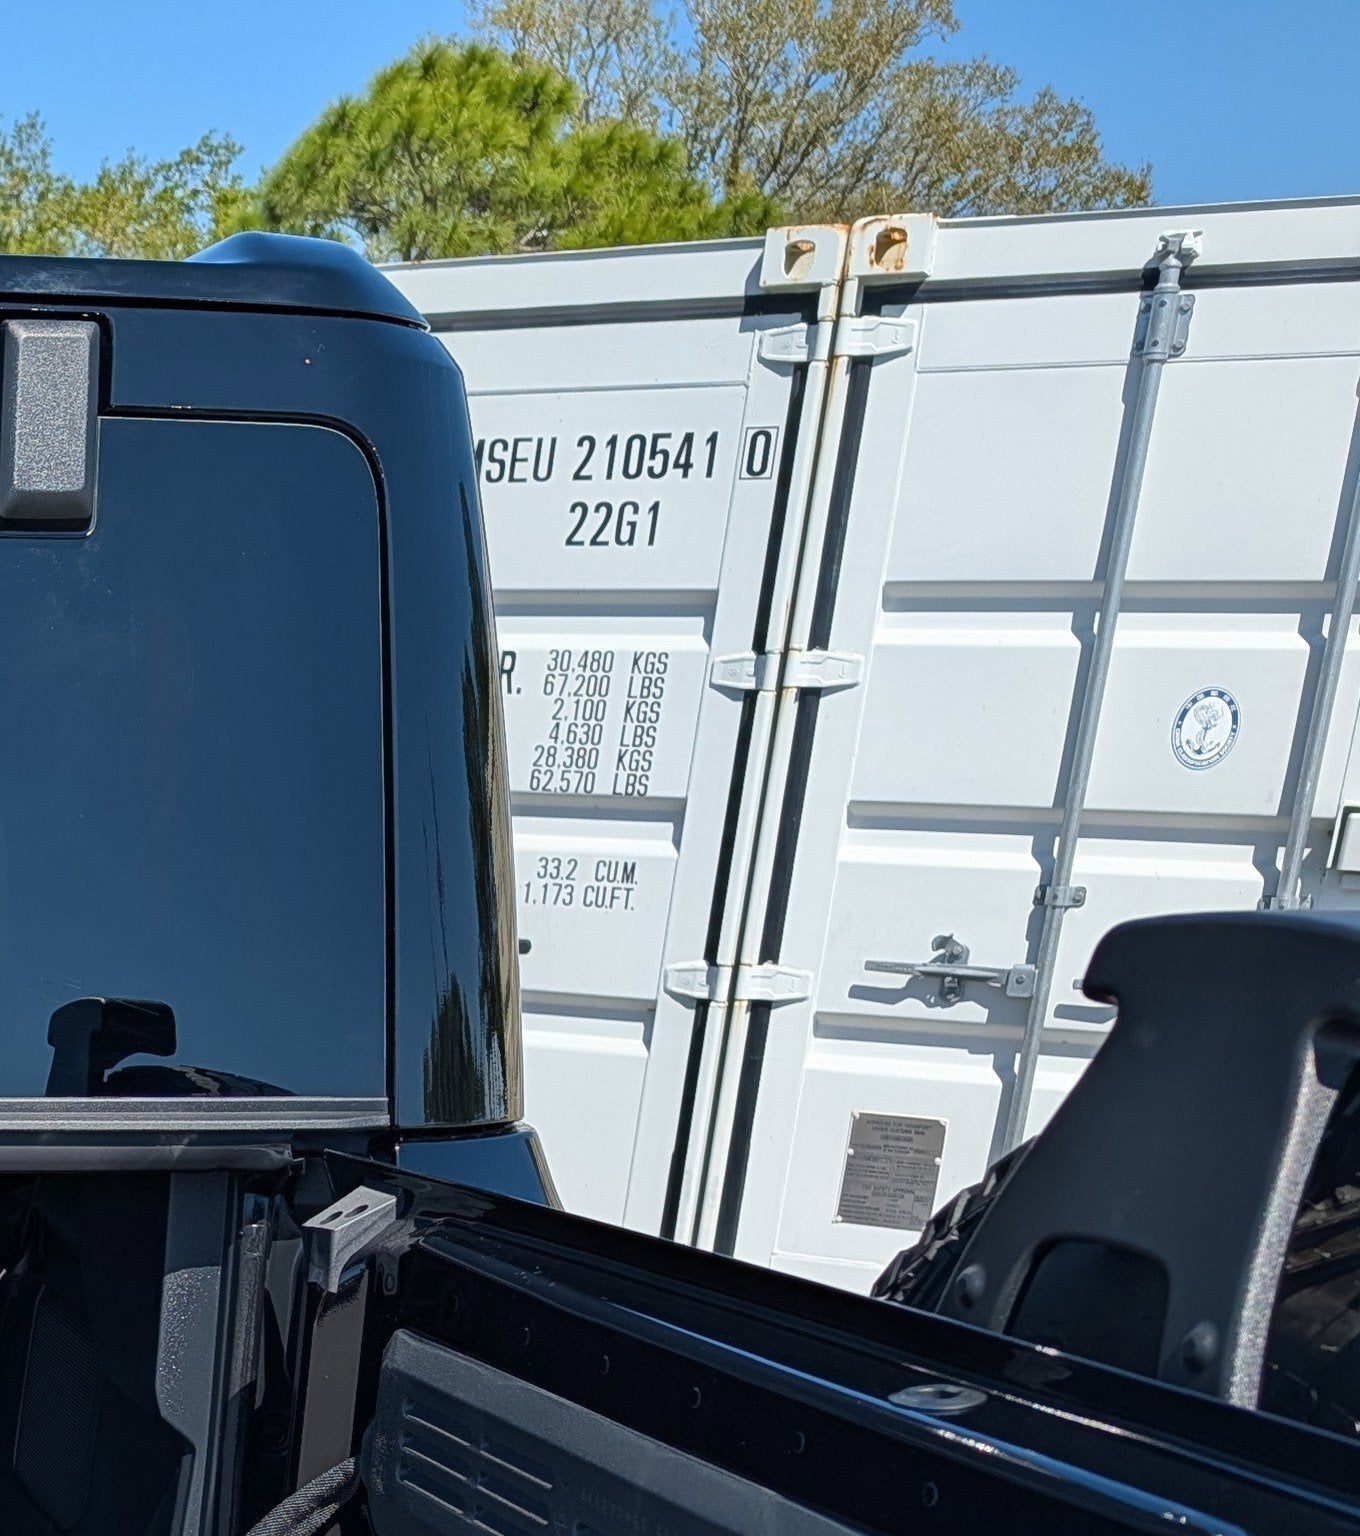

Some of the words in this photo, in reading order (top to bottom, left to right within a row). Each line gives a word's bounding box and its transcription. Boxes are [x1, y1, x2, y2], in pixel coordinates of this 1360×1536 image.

[572, 431, 719, 481] 210541
[745, 430, 772, 477] 0
[565, 500, 661, 547] 22G1
[630, 651, 669, 675] KGS
[627, 676, 665, 699] LBS
[623, 700, 661, 724] KGS
[619, 724, 657, 748] LBS
[615, 748, 654, 772] KGS
[612, 772, 650, 797] LBS
[536, 856, 578, 881] 33.2
